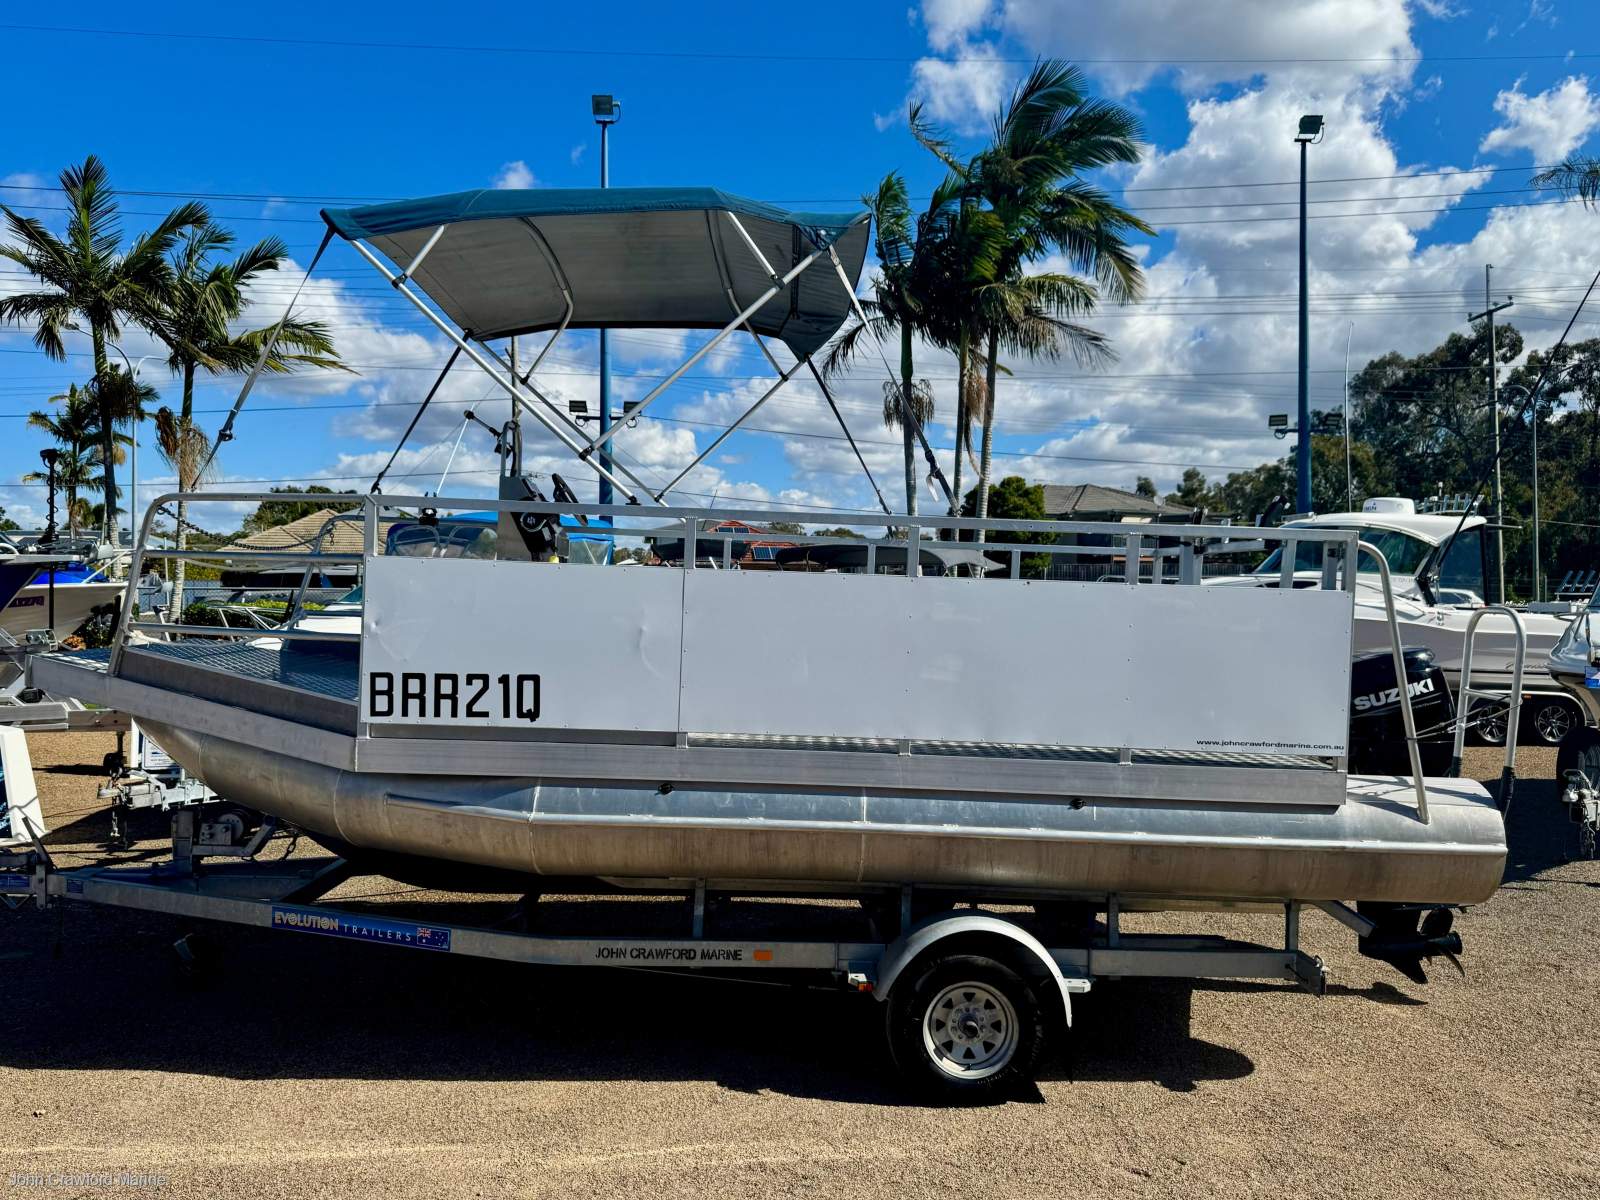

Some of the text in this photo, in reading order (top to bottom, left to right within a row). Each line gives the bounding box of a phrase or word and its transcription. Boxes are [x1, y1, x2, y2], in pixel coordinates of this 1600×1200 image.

[369, 671, 541, 723] BRR21Q
[1196, 739, 1345, 750] www.johncrawfordmarine.com.au
[274, 911, 412, 942] EVOLUTION TRAILERS
[595, 947, 743, 961] JOHN CRAWFORD MARINE
